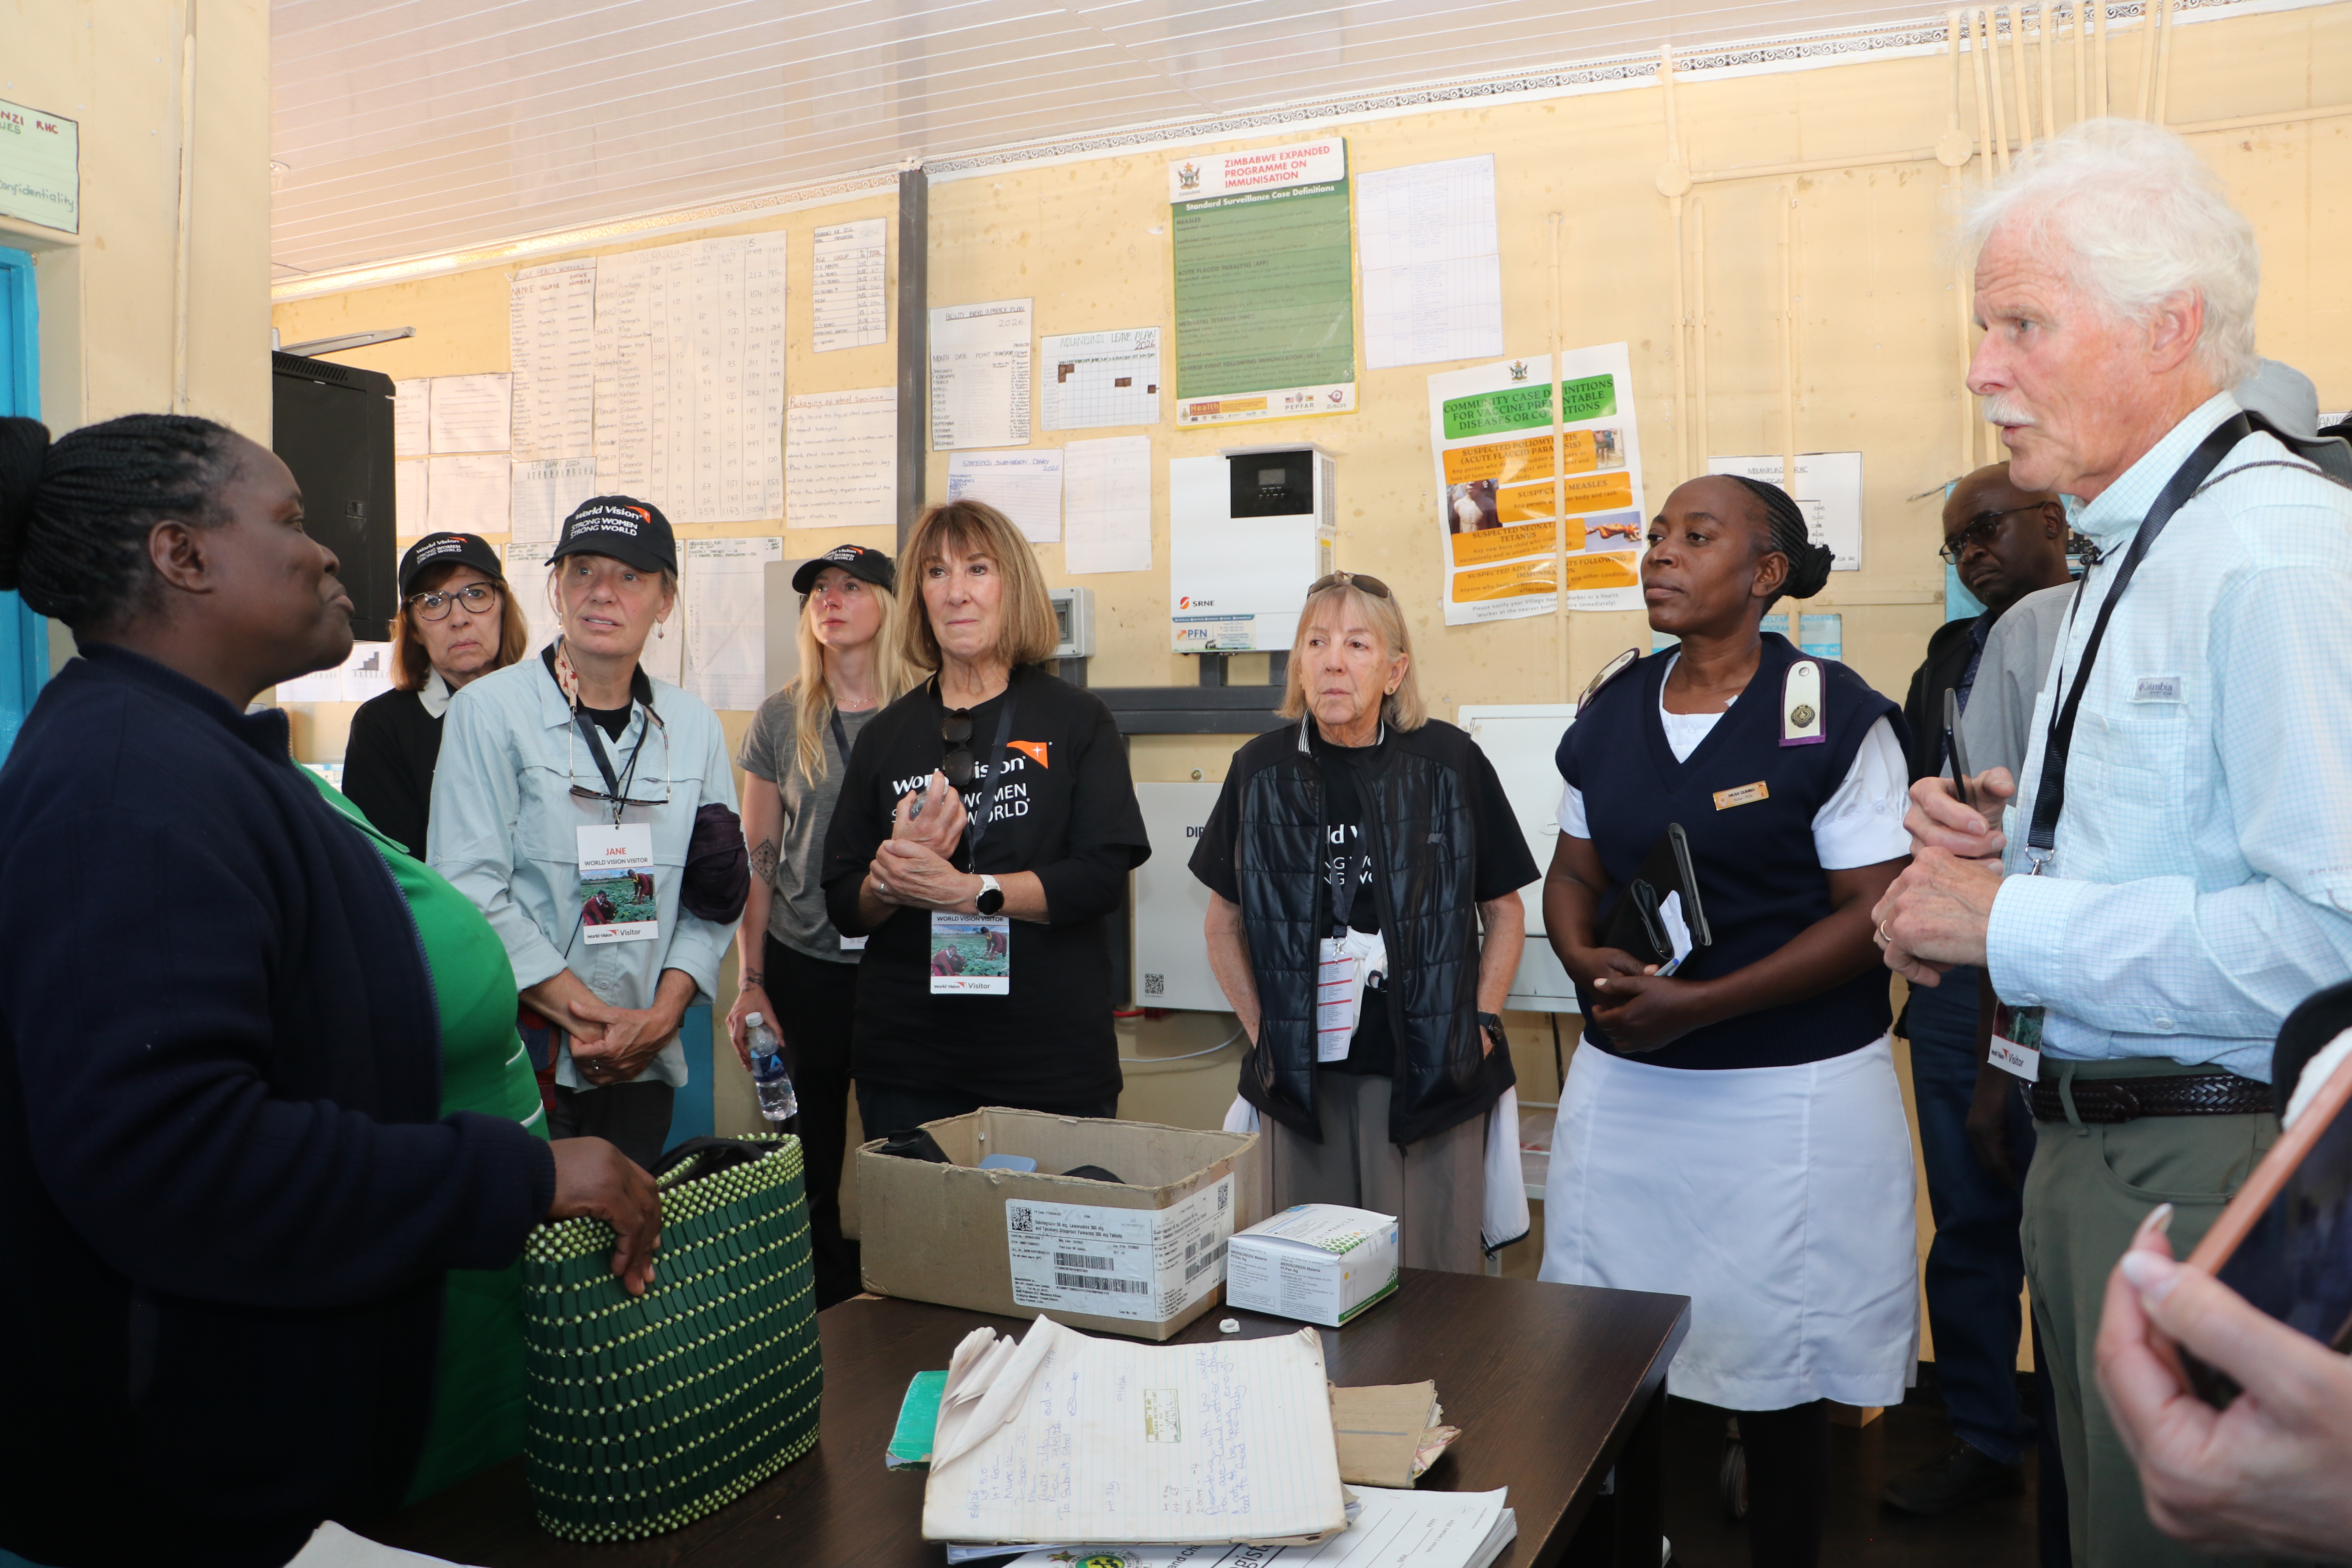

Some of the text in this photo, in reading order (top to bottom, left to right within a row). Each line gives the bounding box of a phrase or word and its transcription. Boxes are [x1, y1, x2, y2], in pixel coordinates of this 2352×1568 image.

[36, 121, 58, 134] RHC
[1225, 146, 1330, 168] ZIMBABWE EXPANDED
[1225, 160, 1307, 178] PROGRAMME ON
[1225, 171, 1299, 188] IMMUNISATION
[1186, 185, 1335, 211] Standard Surveillance Case Definitions
[1177, 217, 1201, 225] MEASLES
[703, 238, 756, 253] RHC 2026
[1197, 265, 1220, 274] FLACCID
[1221, 262, 1252, 272] PARALYSIS
[511, 285, 535, 295] NAME
[946, 312, 965, 320] FACILITY
[1179, 315, 1236, 327] NEONATAL TETANUS
[999, 319, 1024, 327] 2026
[1111, 333, 1131, 343] LEAVE
[1135, 330, 1156, 340] PLAN
[1134, 339, 1156, 350] 2026
[1180, 354, 1303, 372] ADVERSE EVENT FOLLOWING IMMUNIZATION
[789, 396, 822, 409] Packaging
[1191, 402, 1219, 412] Health
[1285, 402, 1315, 410] PEPFAR
[1444, 394, 1509, 413] COMMUNITY
[1513, 391, 1540, 402] CASE
[1453, 404, 1524, 421] FOR VACCINE
[1460, 413, 1529, 430] DISEASES OR
[1462, 444, 1511, 456] SUSPECTED
[1461, 449, 1530, 465] (ACUTE FLACCID
[1569, 479, 1608, 491] MEASLES
[575, 506, 603, 519] World
[571, 517, 638, 531] STRONG WOMEN
[570, 525, 637, 539] STRONG WORLD
[1472, 526, 1519, 539] SUSPECTED
[1500, 532, 1537, 542] TETANUS
[416, 542, 436, 554] World
[1579, 555, 1626, 565] FOLLOWING
[1468, 568, 1510, 579] SUSPECTED
[1492, 603, 1509, 612] notify
[1525, 597, 1545, 606] Village
[1188, 629, 1207, 637] PFN
[2144, 681, 2172, 691] Columbia
[606, 847, 627, 856] JANE
[2009, 1053, 2024, 1067] Visitor
[1231, 1250, 1254, 1258] MERISCREEN
[1280, 1262, 1306, 1270] MERISCREEN
[1114, 1375, 1126, 1402] 29/4/26
[1210, 1381, 1221, 1423] mother
[1058, 1462, 1071, 1521] To Submit
[1426, 1518, 1438, 1528] YYYY
